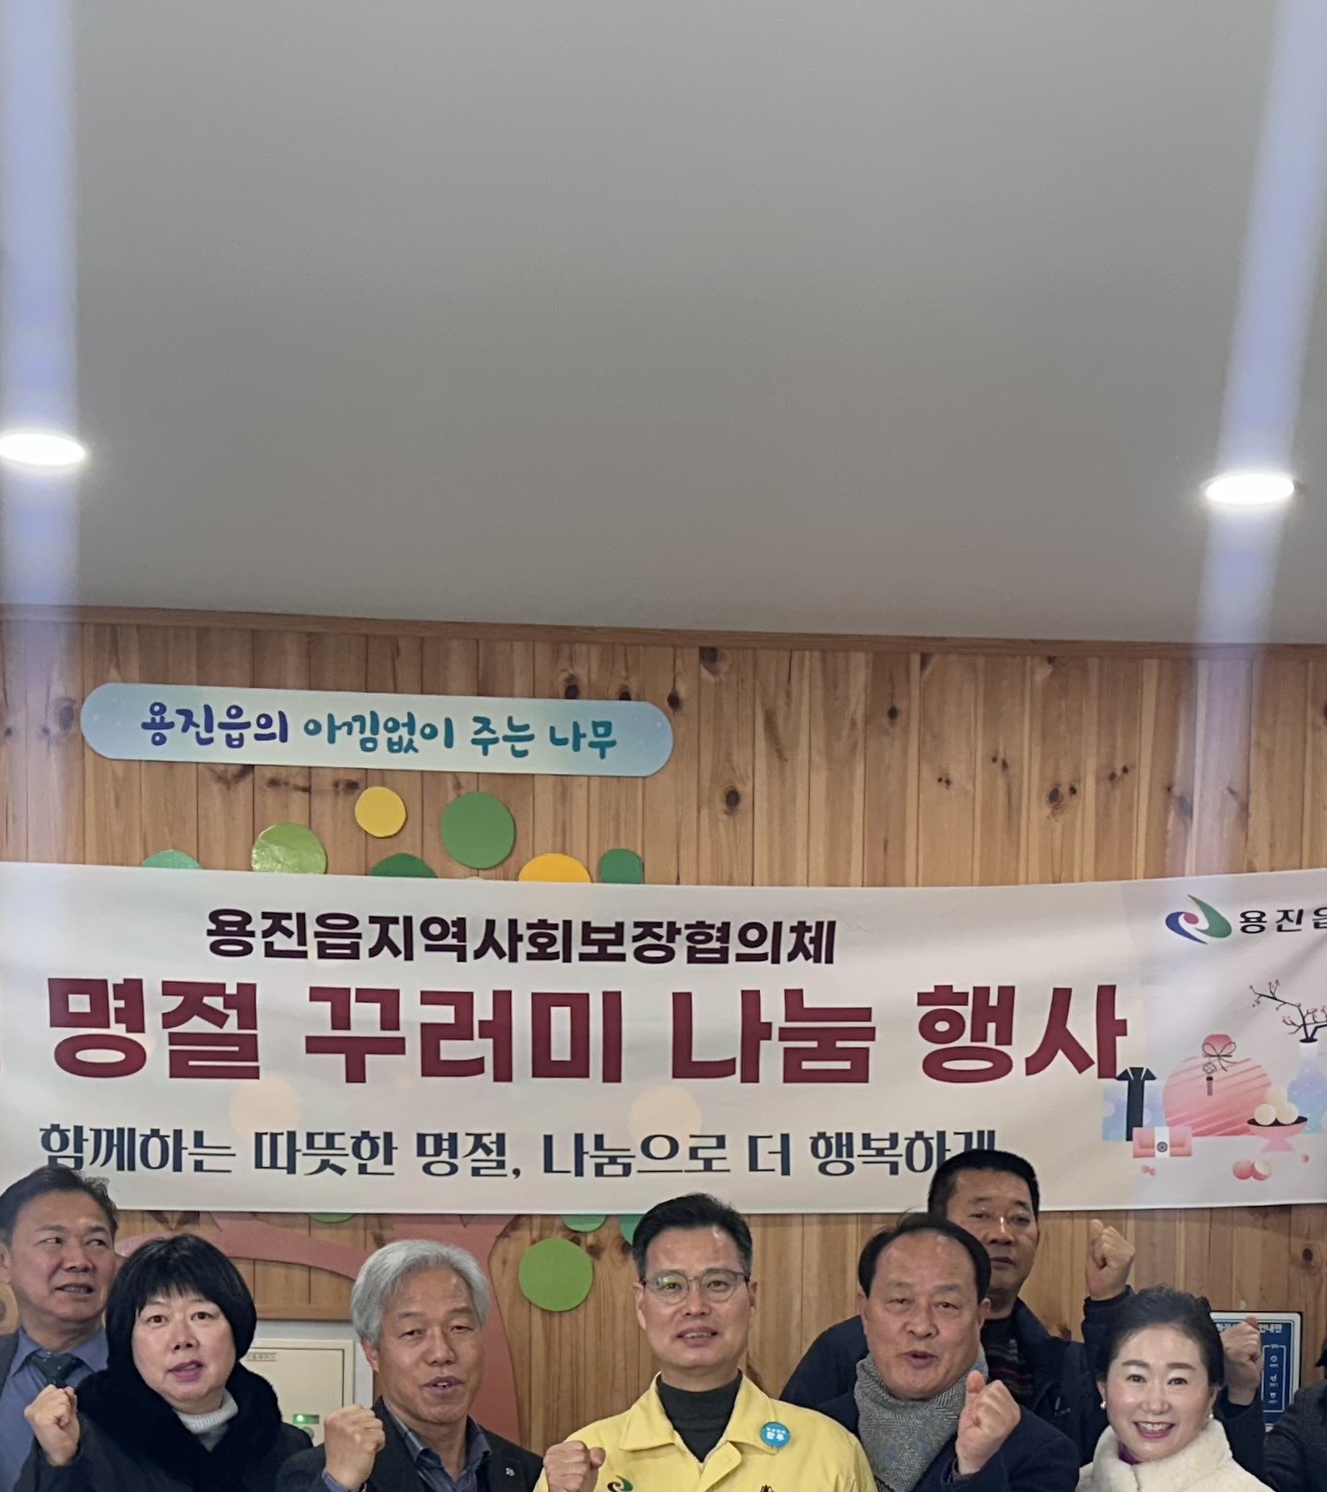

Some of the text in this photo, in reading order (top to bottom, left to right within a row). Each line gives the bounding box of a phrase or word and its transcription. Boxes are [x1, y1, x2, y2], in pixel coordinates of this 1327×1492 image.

[141, 701, 617, 759] 용진읍의 아낌없이 주는 나무
[206, 908, 836, 966] 용진읍지역사회보장협의체
[47, 977, 261, 1080] 명절
[305, 985, 624, 1083] 꾸러미
[671, 990, 876, 1084] 나눔
[916, 983, 1129, 1084] 행사
[39, 1124, 237, 1174] 함께하는
[254, 1130, 398, 1177] 따뜻한
[415, 1131, 522, 1179] 명절,
[542, 1131, 731, 1178] 나눔으로
[748, 1133, 791, 1176] 더
